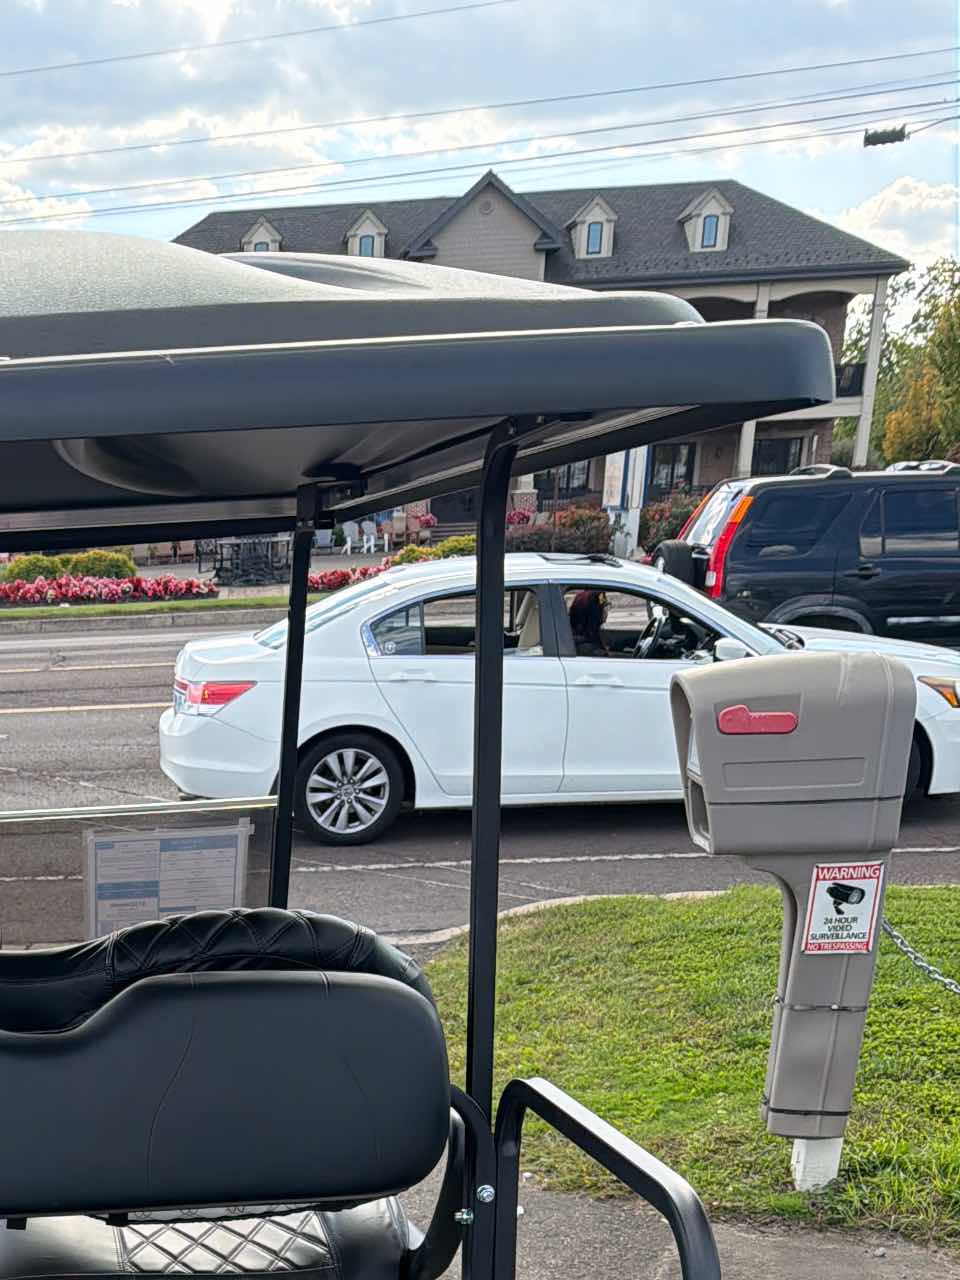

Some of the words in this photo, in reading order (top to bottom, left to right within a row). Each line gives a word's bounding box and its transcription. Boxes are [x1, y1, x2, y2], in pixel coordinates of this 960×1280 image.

[818, 865, 880, 879] WARNING
[824, 917, 832, 925] 24
[835, 916, 858, 924] HOUR
[811, 932, 867, 940] SURVEILLANCE
[807, 943, 819, 951] NO
[820, 942, 867, 950] TRESPASSING
